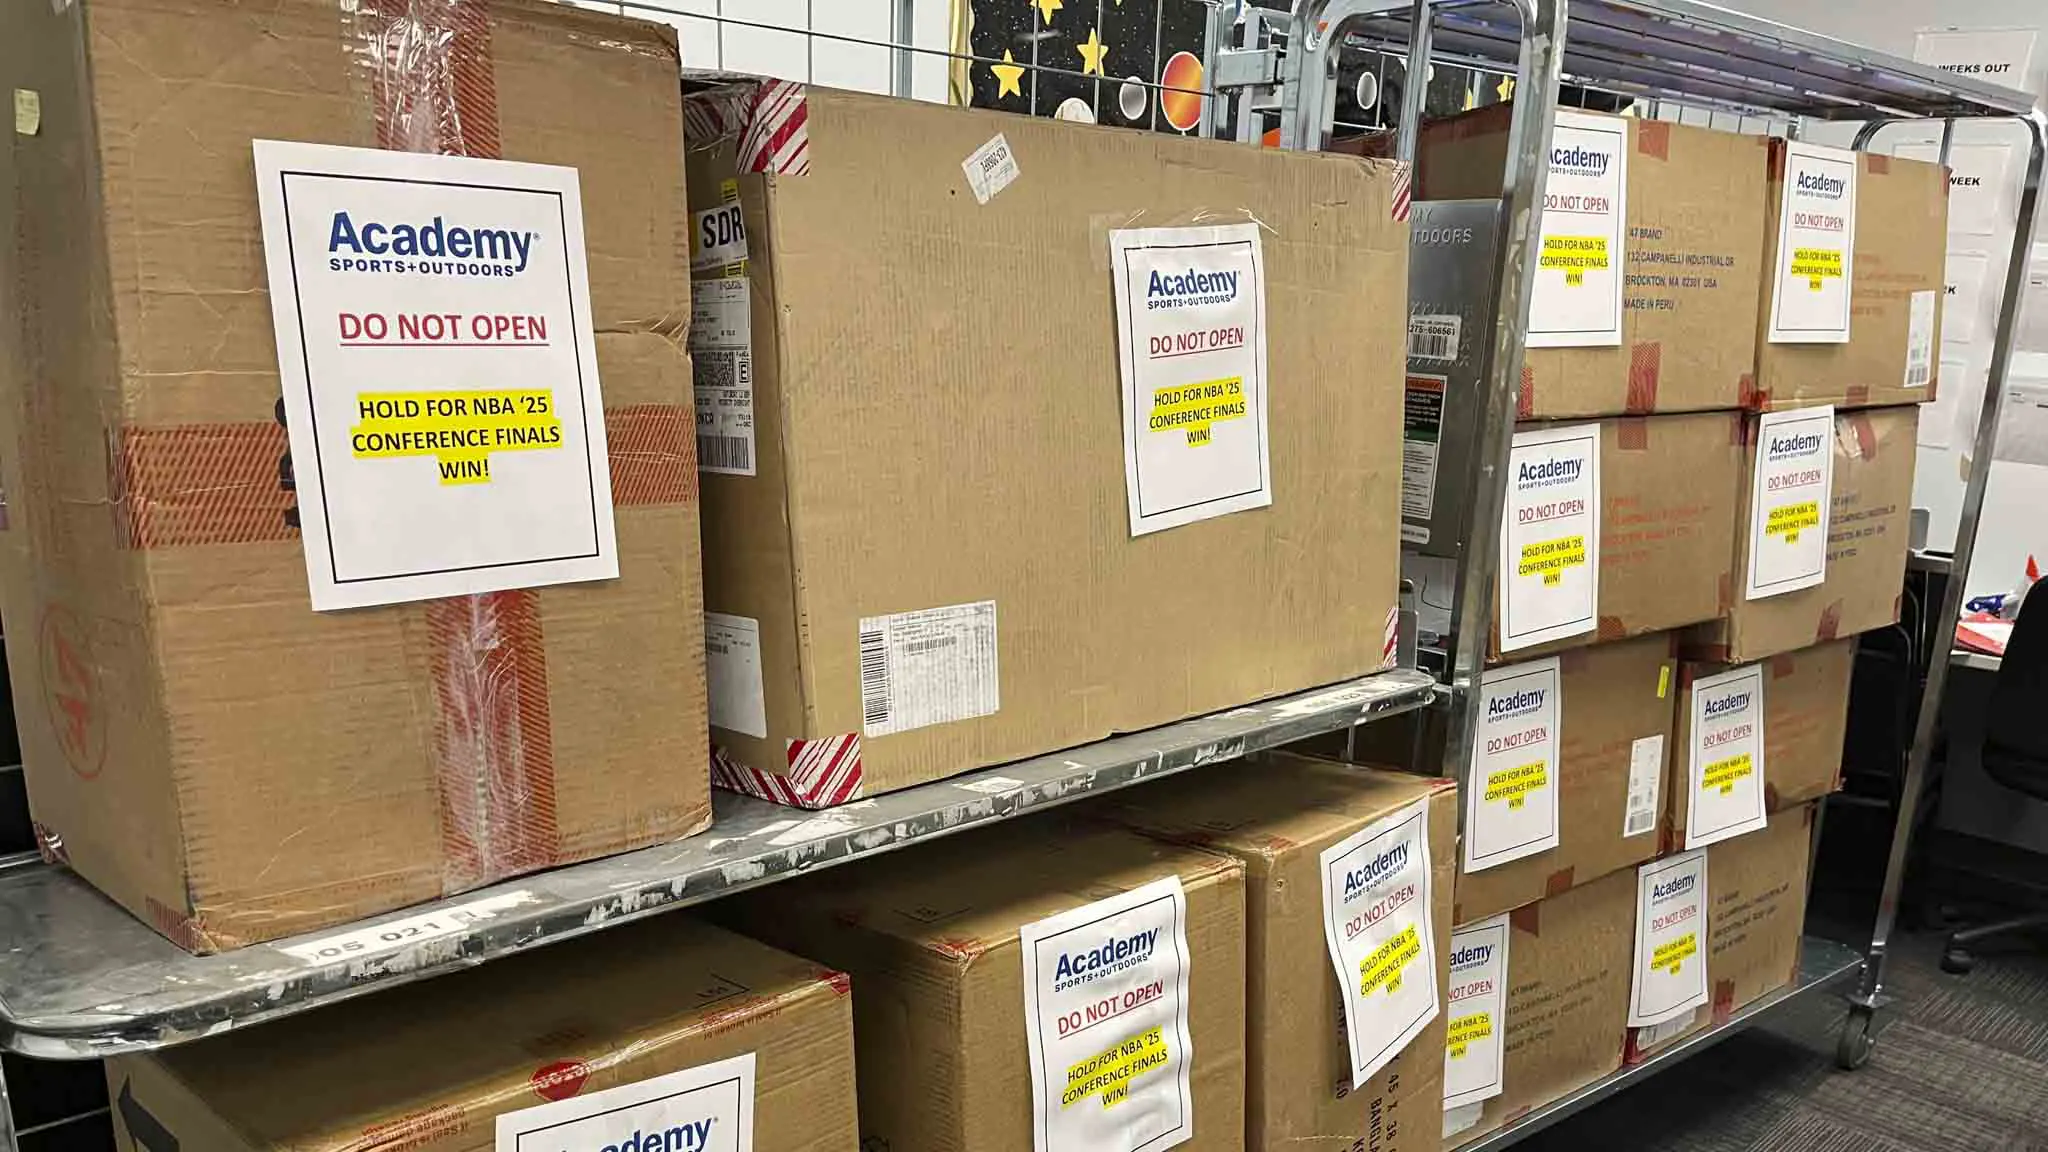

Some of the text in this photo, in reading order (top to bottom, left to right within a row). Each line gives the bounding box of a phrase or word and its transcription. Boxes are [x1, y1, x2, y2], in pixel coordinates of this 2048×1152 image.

[1984, 64, 2010, 73] OUT
[1551, 167, 1600, 177] ORTS+OUTDOORS
[1949, 177, 1981, 186] WEEK
[1797, 170, 1844, 198] Academy
[1543, 194, 1609, 211] DO NOT OPEN
[702, 206, 744, 249] SDR
[1794, 213, 1844, 229] DO NOT OPEN
[329, 212, 531, 272] Academy
[1543, 240, 1563, 250] HOLD
[1564, 240, 1577, 250] FOR
[1579, 240, 1593, 250] NBA
[329, 258, 514, 277] SPORTS+OUTDOORS
[1540, 256, 1608, 268] CONFERENCE FINALS
[1147, 268, 1237, 298] Academy
[1566, 274, 1583, 284] WIN!
[1148, 294, 1231, 310] SPORTS+OUTDOORS
[339, 313, 547, 340] DO NOT OPEN
[1150, 327, 1243, 354] DO NOT OPEN
[1154, 382, 1239, 407] HOLD FOR NBA '25
[359, 397, 548, 419] HOLD FOR NBA '25
[1149, 402, 1245, 429] CONFERENCE FINALS
[352, 426, 560, 452] CONFERENCE FINALS
[1187, 429, 1211, 444] WIN!
[1770, 434, 1821, 454] Academy
[439, 459, 490, 479] WIN!
[1519, 458, 1582, 481] Academy
[1768, 470, 1821, 488] DO NOT OPEN
[1520, 500, 1584, 521] DO NOT OPEN
[1522, 539, 1582, 558] HOLD FOR NBA '25
[1519, 553, 1585, 574] CONFERENCE FINALS
[1544, 574, 1561, 584] WIN!
[1489, 690, 1545, 715] Academy
[1704, 692, 1751, 715] Academy
[1488, 728, 1547, 752] DO NOT OPEN
[1703, 724, 1752, 746] DO NOT OPEN
[1488, 774, 1506, 785] HOLD
[1508, 770, 1520, 780] FOR
[1521, 768, 1534, 778] NBA
[1484, 777, 1547, 801] CONFERENCE FINALS
[1509, 798, 1524, 808] WIN!
[1344, 840, 1408, 894] Academy
[1653, 873, 1696, 898] Academy
[1346, 884, 1415, 937] DO NOT OPEN
[381, 922, 440, 941] 021
[1056, 928, 1158, 981] Academy
[1360, 928, 1416, 976] HOLD FOR NBA '25
[1450, 944, 1492, 966] ademy
[1055, 955, 1149, 992] SPORTS+OUTDOORS
[1360, 944, 1420, 995] CONFERENCE FINALS
[1385, 975, 1402, 994] WIN!
[1448, 981, 1492, 1000] NOT OPEN
[1058, 980, 1163, 1035] DO NOT OPEN
[1067, 1032, 1159, 1084] HOLD FOR NBA '25
[1062, 1050, 1168, 1105] CONFERENCE FINALS
[1102, 1085, 1128, 1105] WIN!
[598, 1117, 712, 1152] demy
